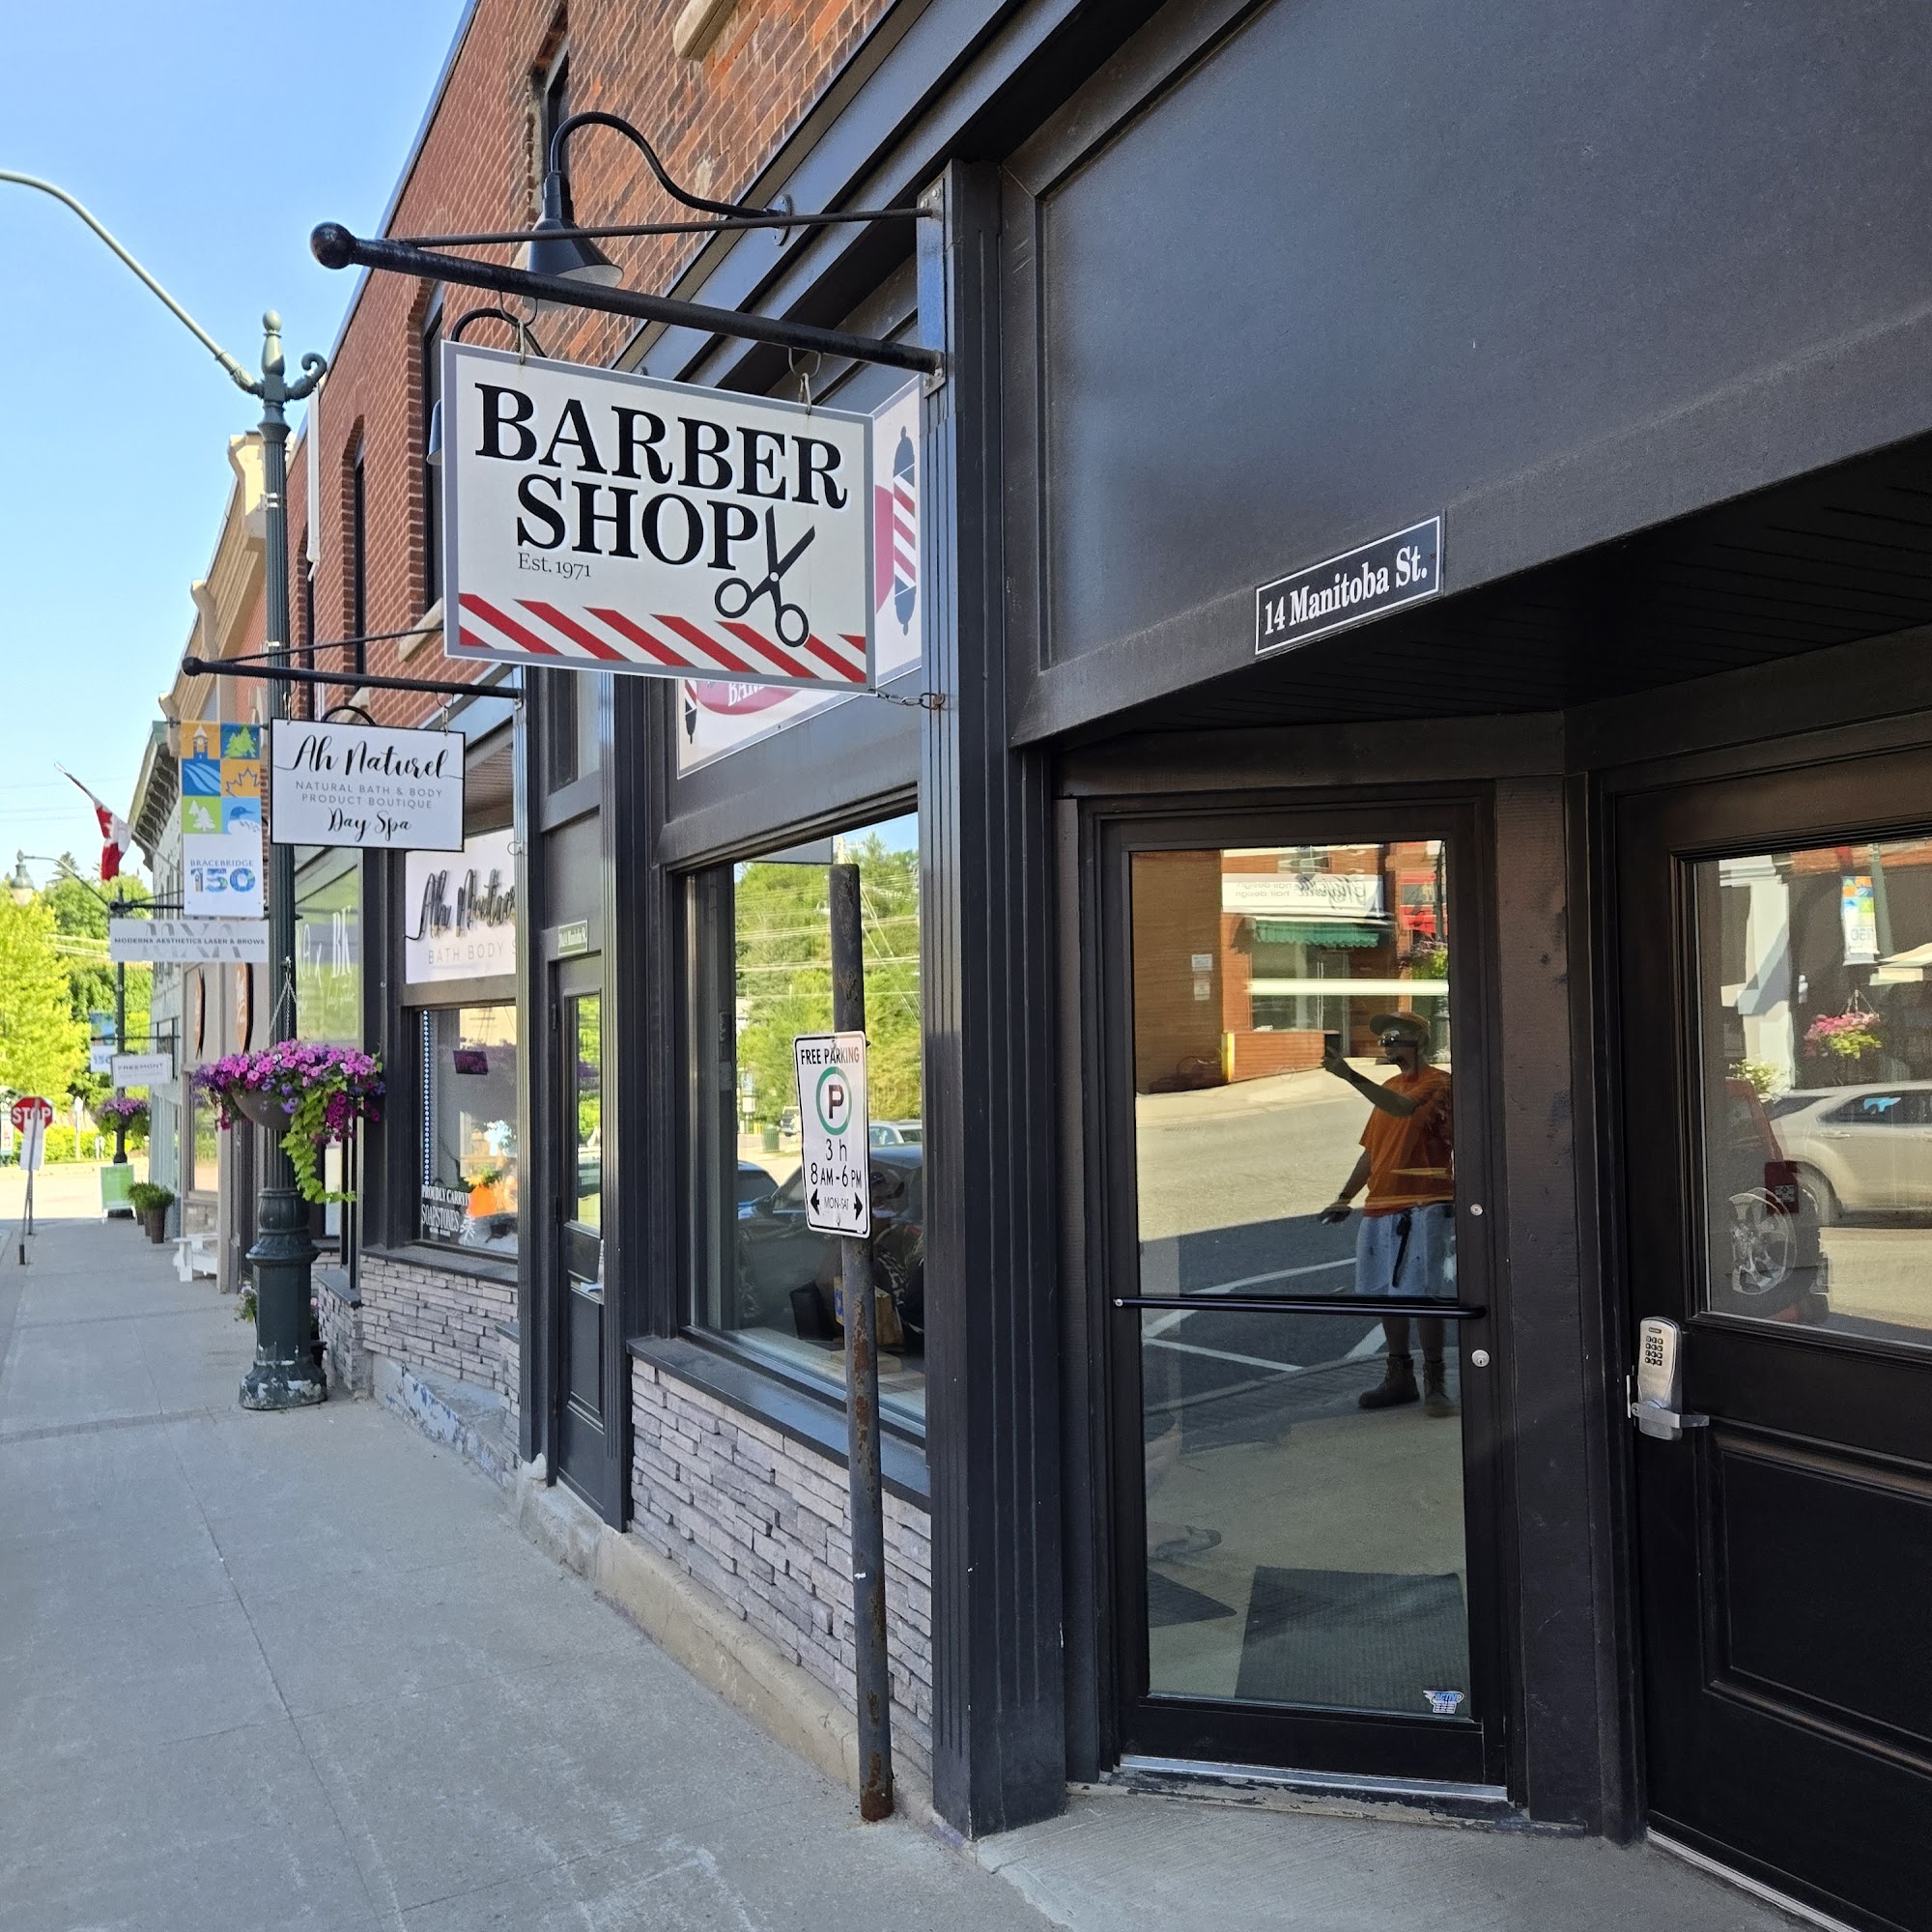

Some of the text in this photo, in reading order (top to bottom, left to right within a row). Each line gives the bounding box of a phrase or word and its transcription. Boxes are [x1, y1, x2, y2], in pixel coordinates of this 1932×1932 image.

[474, 383, 847, 509] BARBER
[516, 473, 758, 570] SHOP
[518, 554, 592, 580] Est. 1971
[1264, 546, 1428, 636] 14 Manitoba St.
[274, 734, 464, 780] Ah Naturel
[296, 781, 442, 798] NATURAL BATH & BODY
[301, 793, 432, 810] PRODUCT BOUTIQUE
[327, 807, 412, 842] Day Spa
[190, 859, 254, 867] BRACEBRIDGE
[190, 867, 256, 893] 150
[428, 948, 460, 965] BATH
[468, 943, 503, 960] BODY
[801, 1048, 860, 1065] FREE PARKING
[828, 1084, 844, 1120] P
[825, 1139, 847, 1162] 3 h
[824, 1196, 849, 1210] MON-SAT
